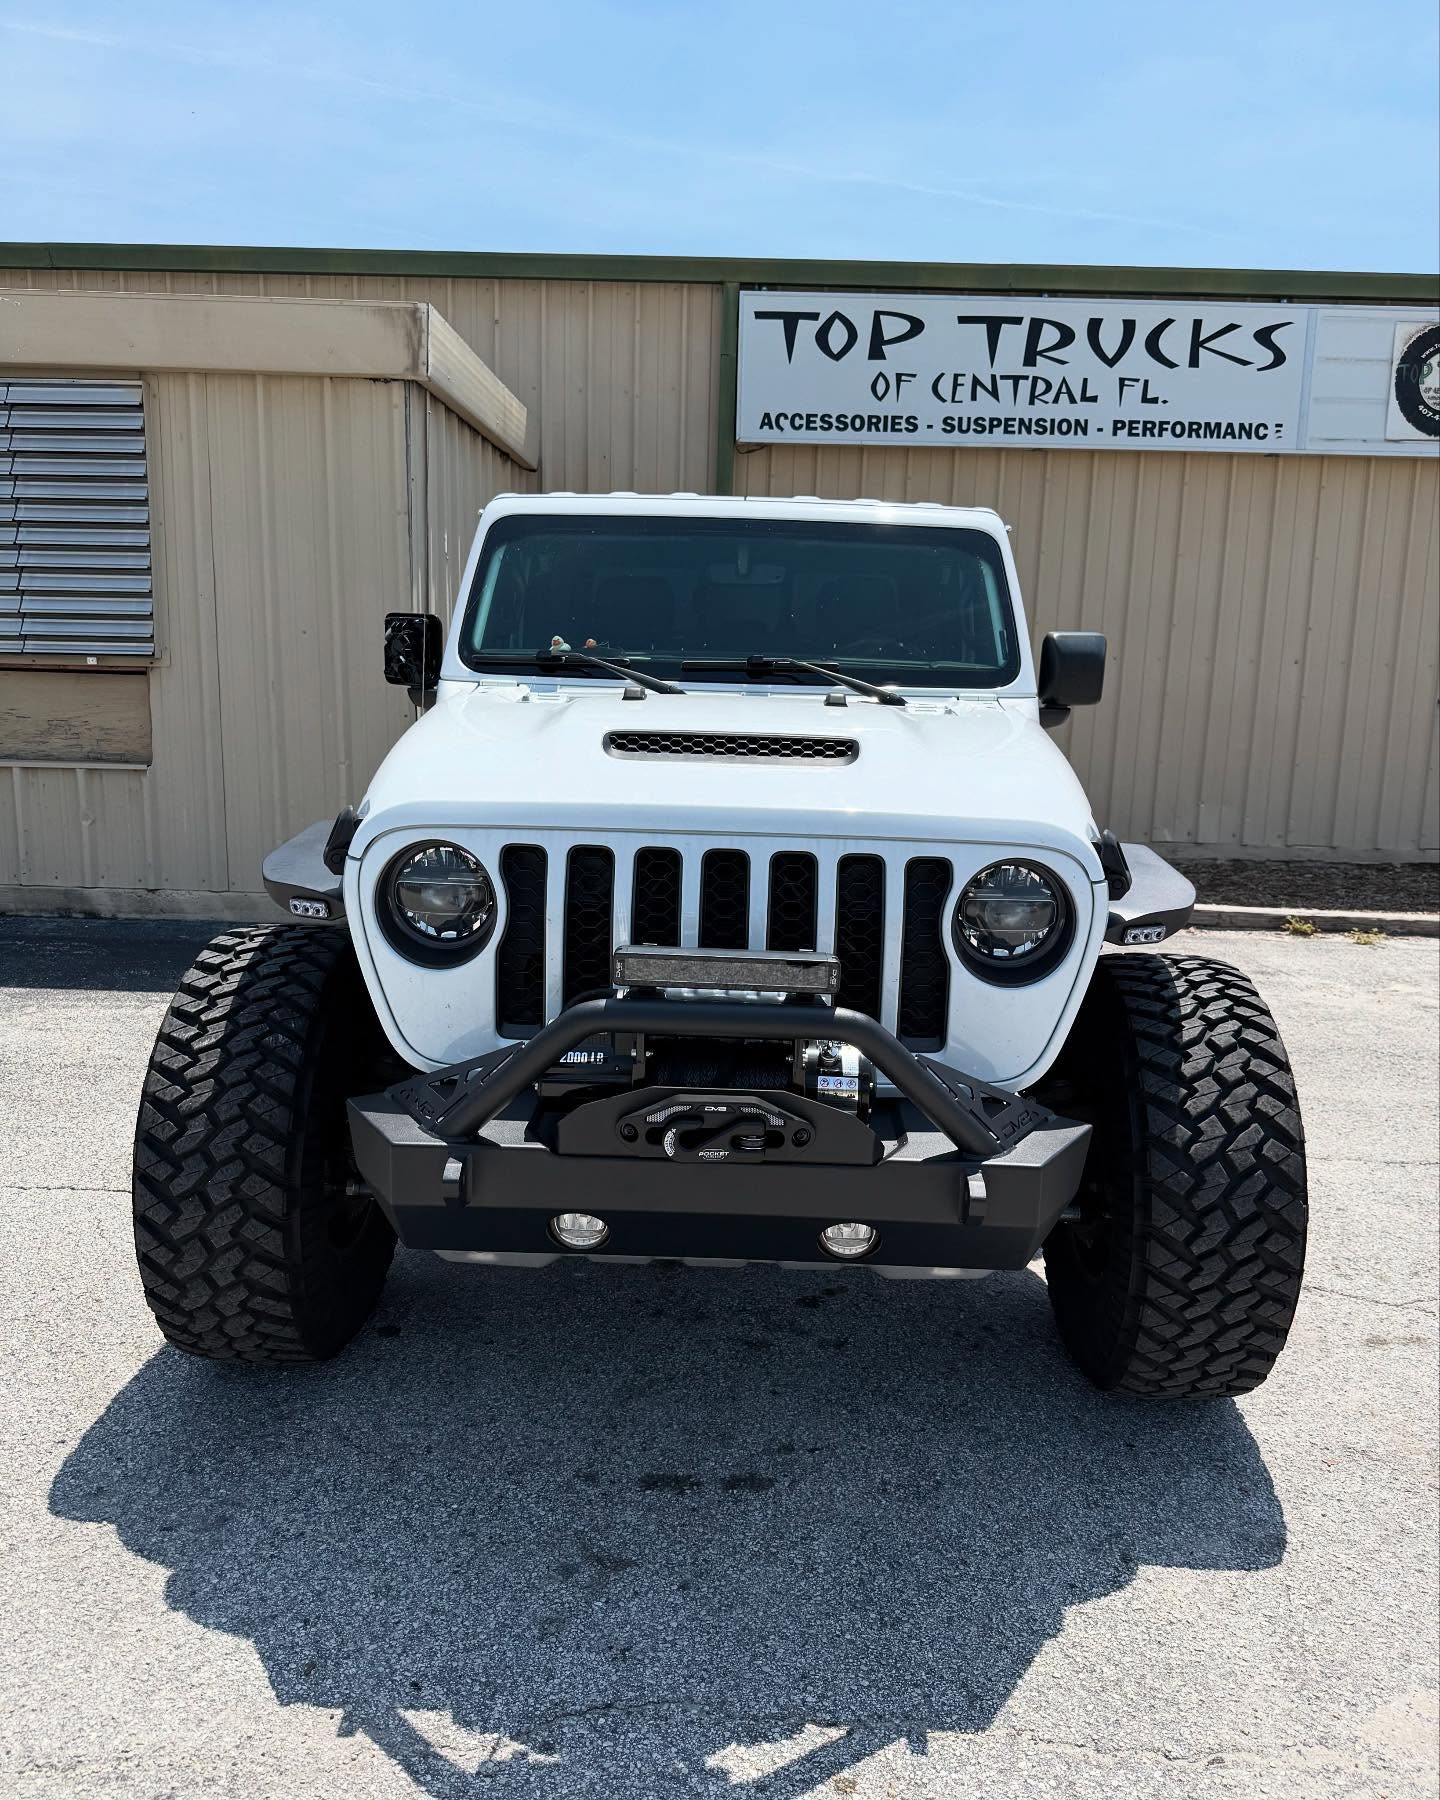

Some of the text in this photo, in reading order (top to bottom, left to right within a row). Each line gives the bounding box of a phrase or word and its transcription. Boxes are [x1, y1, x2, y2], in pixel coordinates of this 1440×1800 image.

[754, 310, 1295, 371] TOP TRUCKS
[870, 371, 1169, 407] OF CENTRAL FL.
[759, 412, 919, 434] ACCESSORIES
[941, 415, 1089, 437] SUSPENSION
